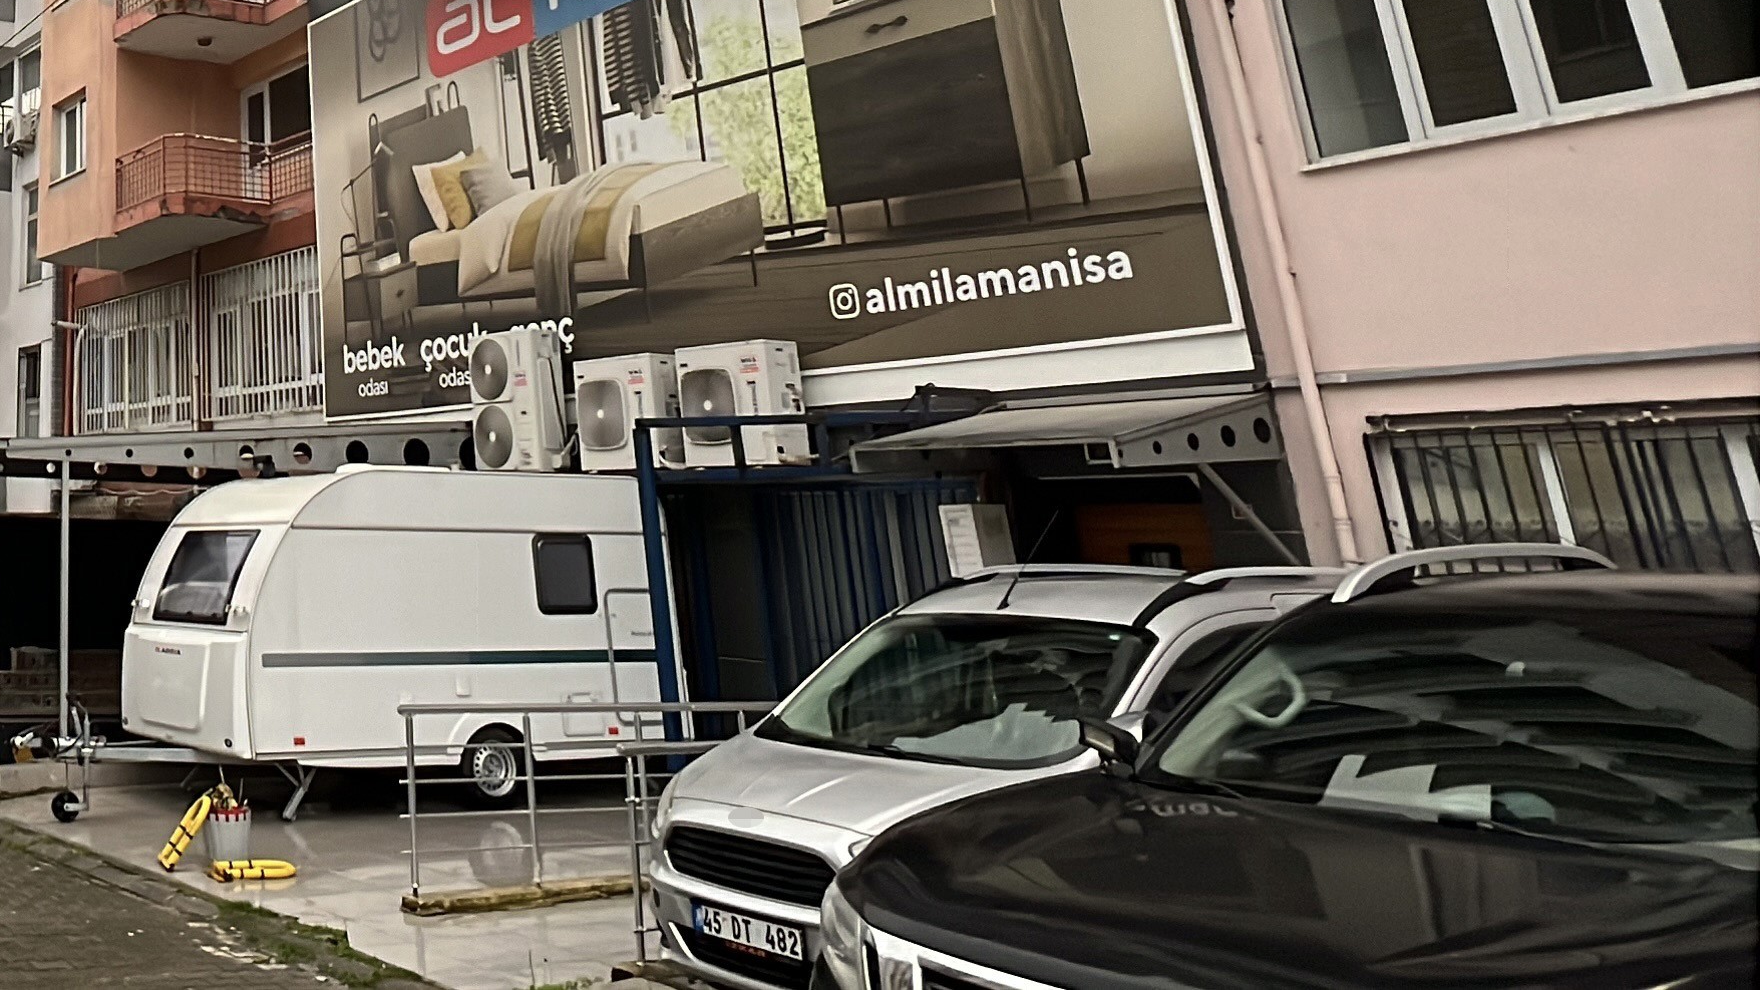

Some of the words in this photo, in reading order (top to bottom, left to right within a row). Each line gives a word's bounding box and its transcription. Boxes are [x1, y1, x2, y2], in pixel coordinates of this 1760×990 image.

[865, 247, 1134, 314] almilamanisa
[343, 336, 406, 374] bebek
[358, 378, 389, 397] odası
[439, 366, 472, 389] odas
[703, 908, 722, 935] 45
[731, 915, 751, 943] DT
[765, 924, 799, 957] 482
